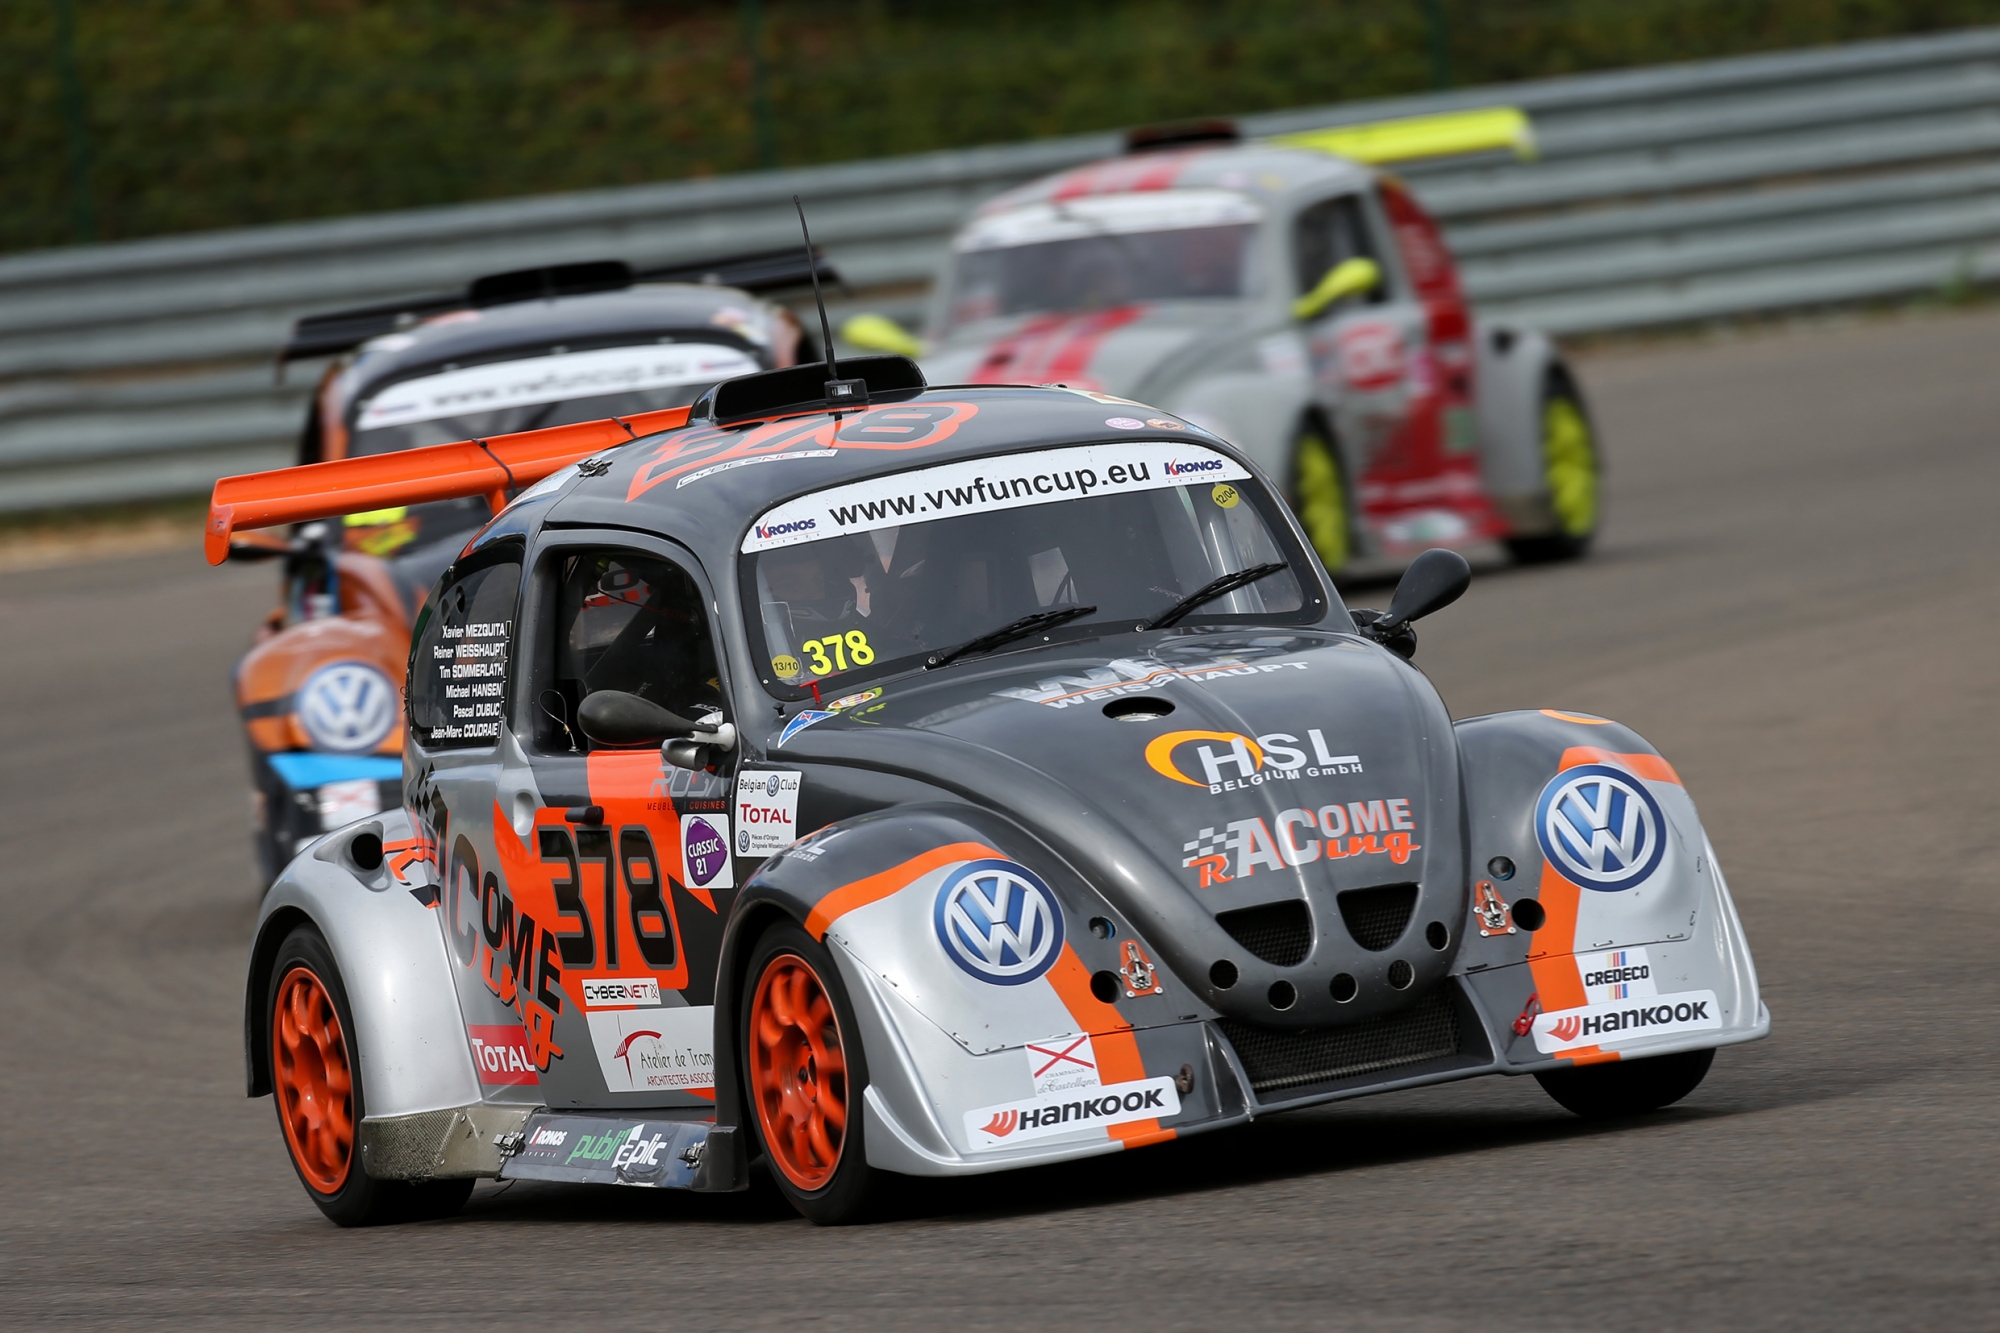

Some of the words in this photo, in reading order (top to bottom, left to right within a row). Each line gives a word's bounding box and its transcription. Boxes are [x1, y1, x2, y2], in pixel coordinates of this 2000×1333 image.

[1164, 458, 1223, 476] KRONOS
[829, 461, 1150, 526] www.vwfuncup.eu
[1215, 487, 1236, 504] 12/04
[755, 519, 816, 539] KRONOS
[442, 624, 464, 639] Xavier
[455, 642, 504, 658] WEISSHAUPT
[802, 630, 875, 676] 378
[439, 665, 451, 679] Tim
[452, 662, 503, 678] SOMMERLATH
[774, 661, 798, 671] 13/10
[446, 684, 470, 698] Michael
[471, 682, 502, 698] HANSEN
[1044, 661, 1309, 709] WEISSHAUPT
[453, 704, 475, 718] Pascal
[476, 702, 500, 717] DUBUC
[431, 725, 463, 739] Jean-Marc
[463, 722, 498, 738] COUDRAIE
[1196, 728, 1360, 784] HSL
[739, 778, 766, 793] Belgian
[780, 778, 798, 792] Club
[1209, 769, 1300, 795] BELGIUM
[1306, 763, 1363, 777] GmbH
[689, 800, 726, 810] CUISINES
[740, 803, 792, 824] TOTAL
[687, 837, 720, 859] CLASSIC
[695, 859, 708, 876] 21
[537, 824, 678, 970] 378
[1585, 965, 1649, 987] CREDECO
[585, 984, 649, 1000] CYBERNET
[472, 1038, 536, 1072] TOTAL
[641, 1049, 672, 1069] Atelier
[675, 1048, 687, 1068] de
[647, 1073, 689, 1087] ARCHITECTES
[1045, 1067, 1085, 1079] CHAMPAGNE
